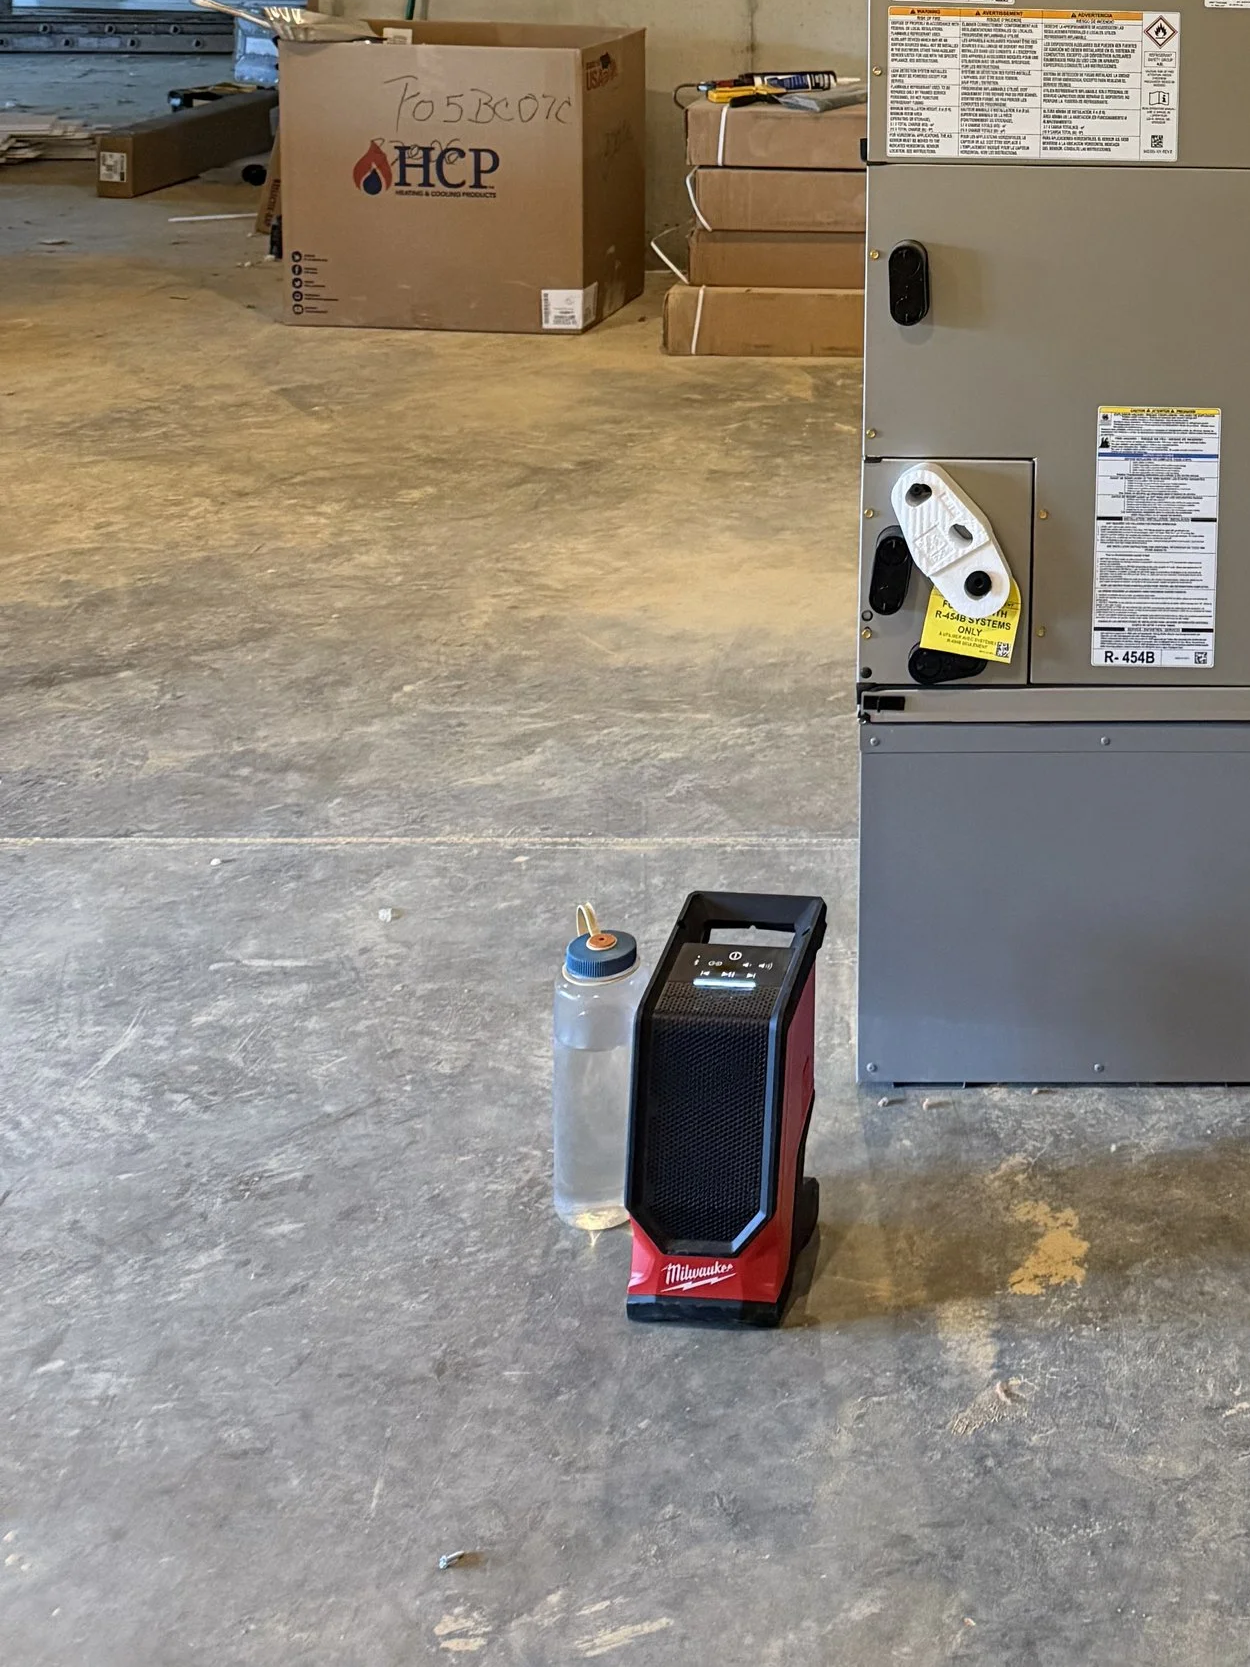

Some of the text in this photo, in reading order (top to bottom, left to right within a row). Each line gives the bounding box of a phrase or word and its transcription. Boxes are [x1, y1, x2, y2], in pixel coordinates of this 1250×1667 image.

[394, 146, 500, 189] HCP
[431, 190, 460, 198] COOLING
[462, 190, 496, 198] PRODUCTS
[935, 610, 1012, 631] R-454B SYSTEMS
[957, 626, 982, 637] ONLY
[1122, 651, 1155, 664] 454B
[661, 1260, 734, 1285] Milwaukee
